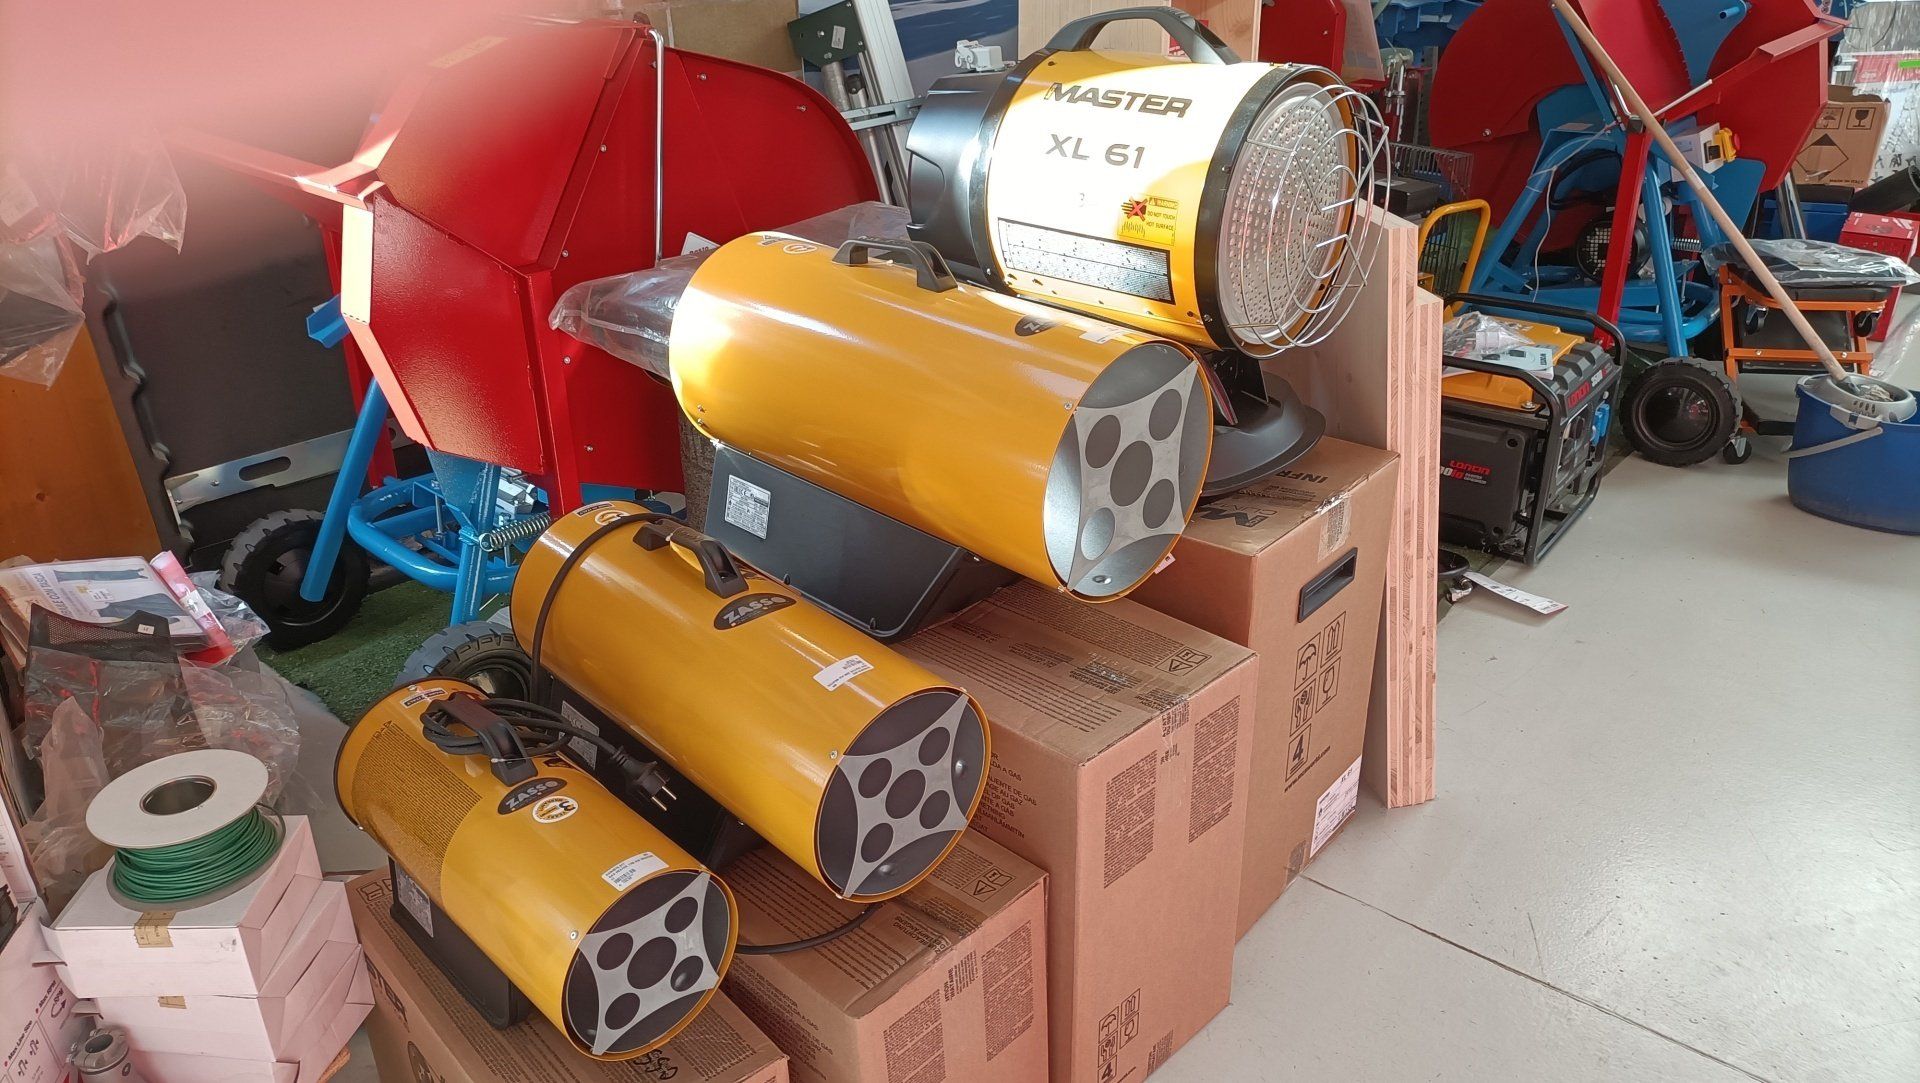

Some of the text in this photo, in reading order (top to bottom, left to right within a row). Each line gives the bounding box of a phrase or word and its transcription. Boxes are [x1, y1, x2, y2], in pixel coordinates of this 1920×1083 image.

[1044, 82, 1192, 118] MASTER
[1046, 134, 1145, 168] XL 61
[723, 596, 787, 624] ZASSO
[1008, 769, 1022, 781] GAS
[506, 781, 558, 808] ZASSO
